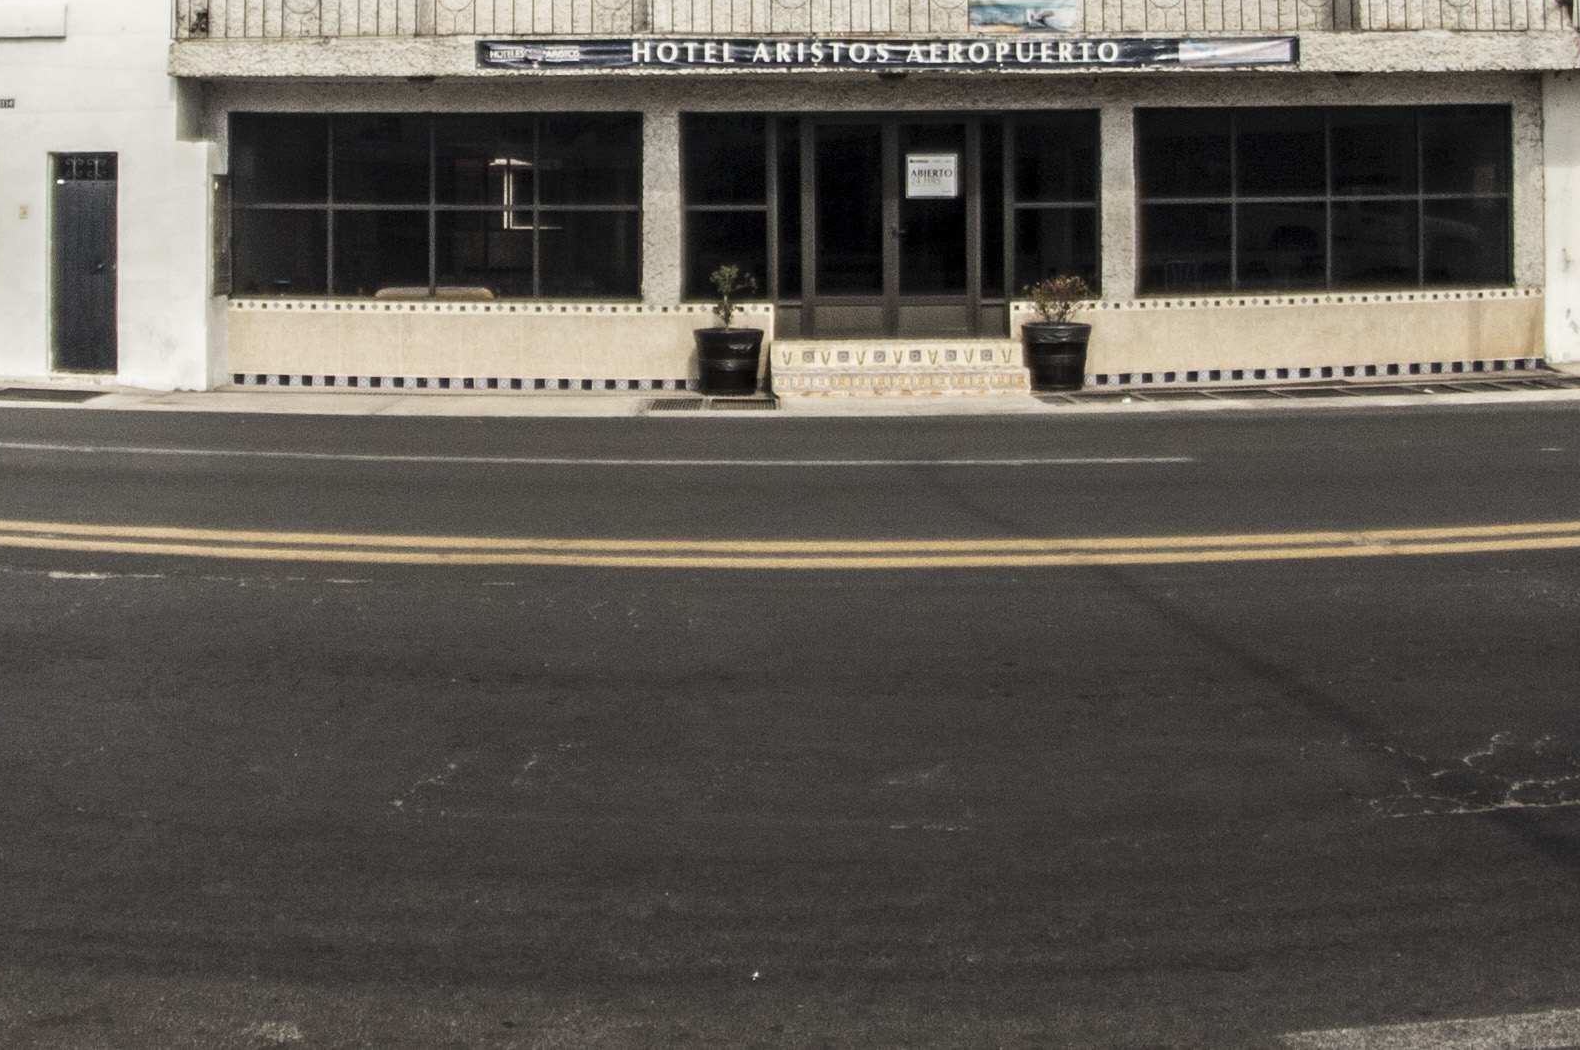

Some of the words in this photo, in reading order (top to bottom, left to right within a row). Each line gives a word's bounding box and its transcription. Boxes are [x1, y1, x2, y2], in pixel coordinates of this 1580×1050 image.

[489, 49, 525, 59] HOTELES
[631, 41, 735, 64] HOTEL
[752, 41, 890, 64] ARISTOS
[905, 41, 1120, 64] AEROPUERTO
[910, 168, 953, 178] ABIERTO
